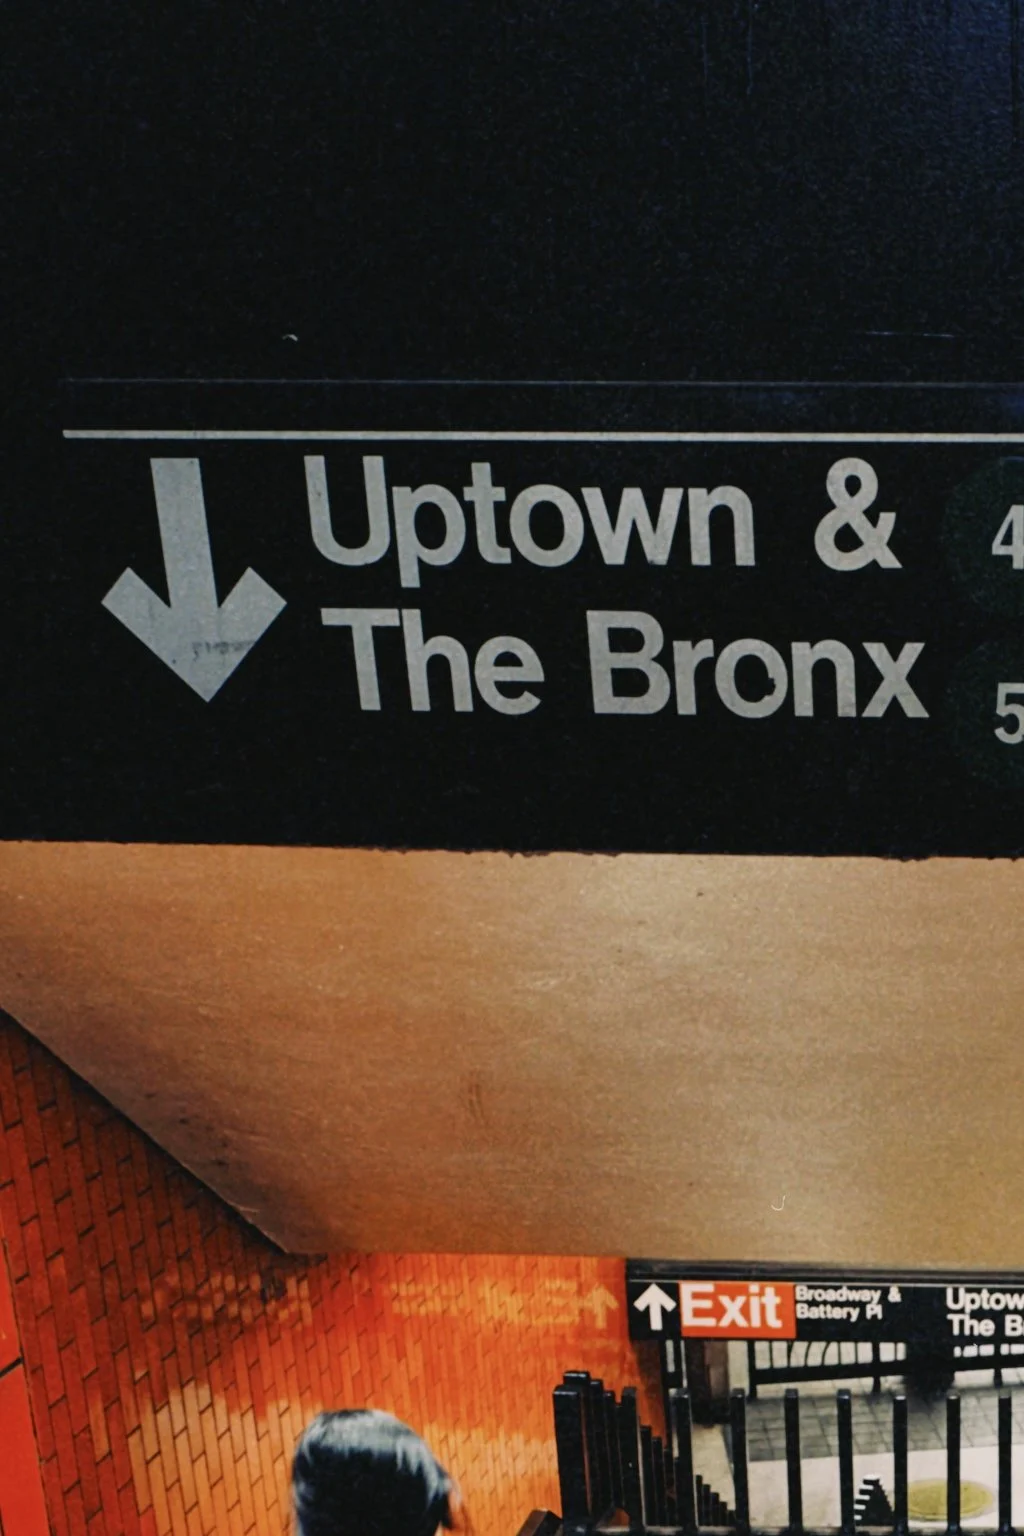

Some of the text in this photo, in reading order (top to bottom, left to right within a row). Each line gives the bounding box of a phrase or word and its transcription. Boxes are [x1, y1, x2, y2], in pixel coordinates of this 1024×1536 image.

[303, 454, 903, 588] Uptown &
[320, 607, 931, 720] The Bronx
[680, 1282, 784, 1329] Exit
[795, 1285, 903, 1305] Broadway &
[796, 1302, 861, 1323] Battery
[946, 1312, 997, 1338] The
